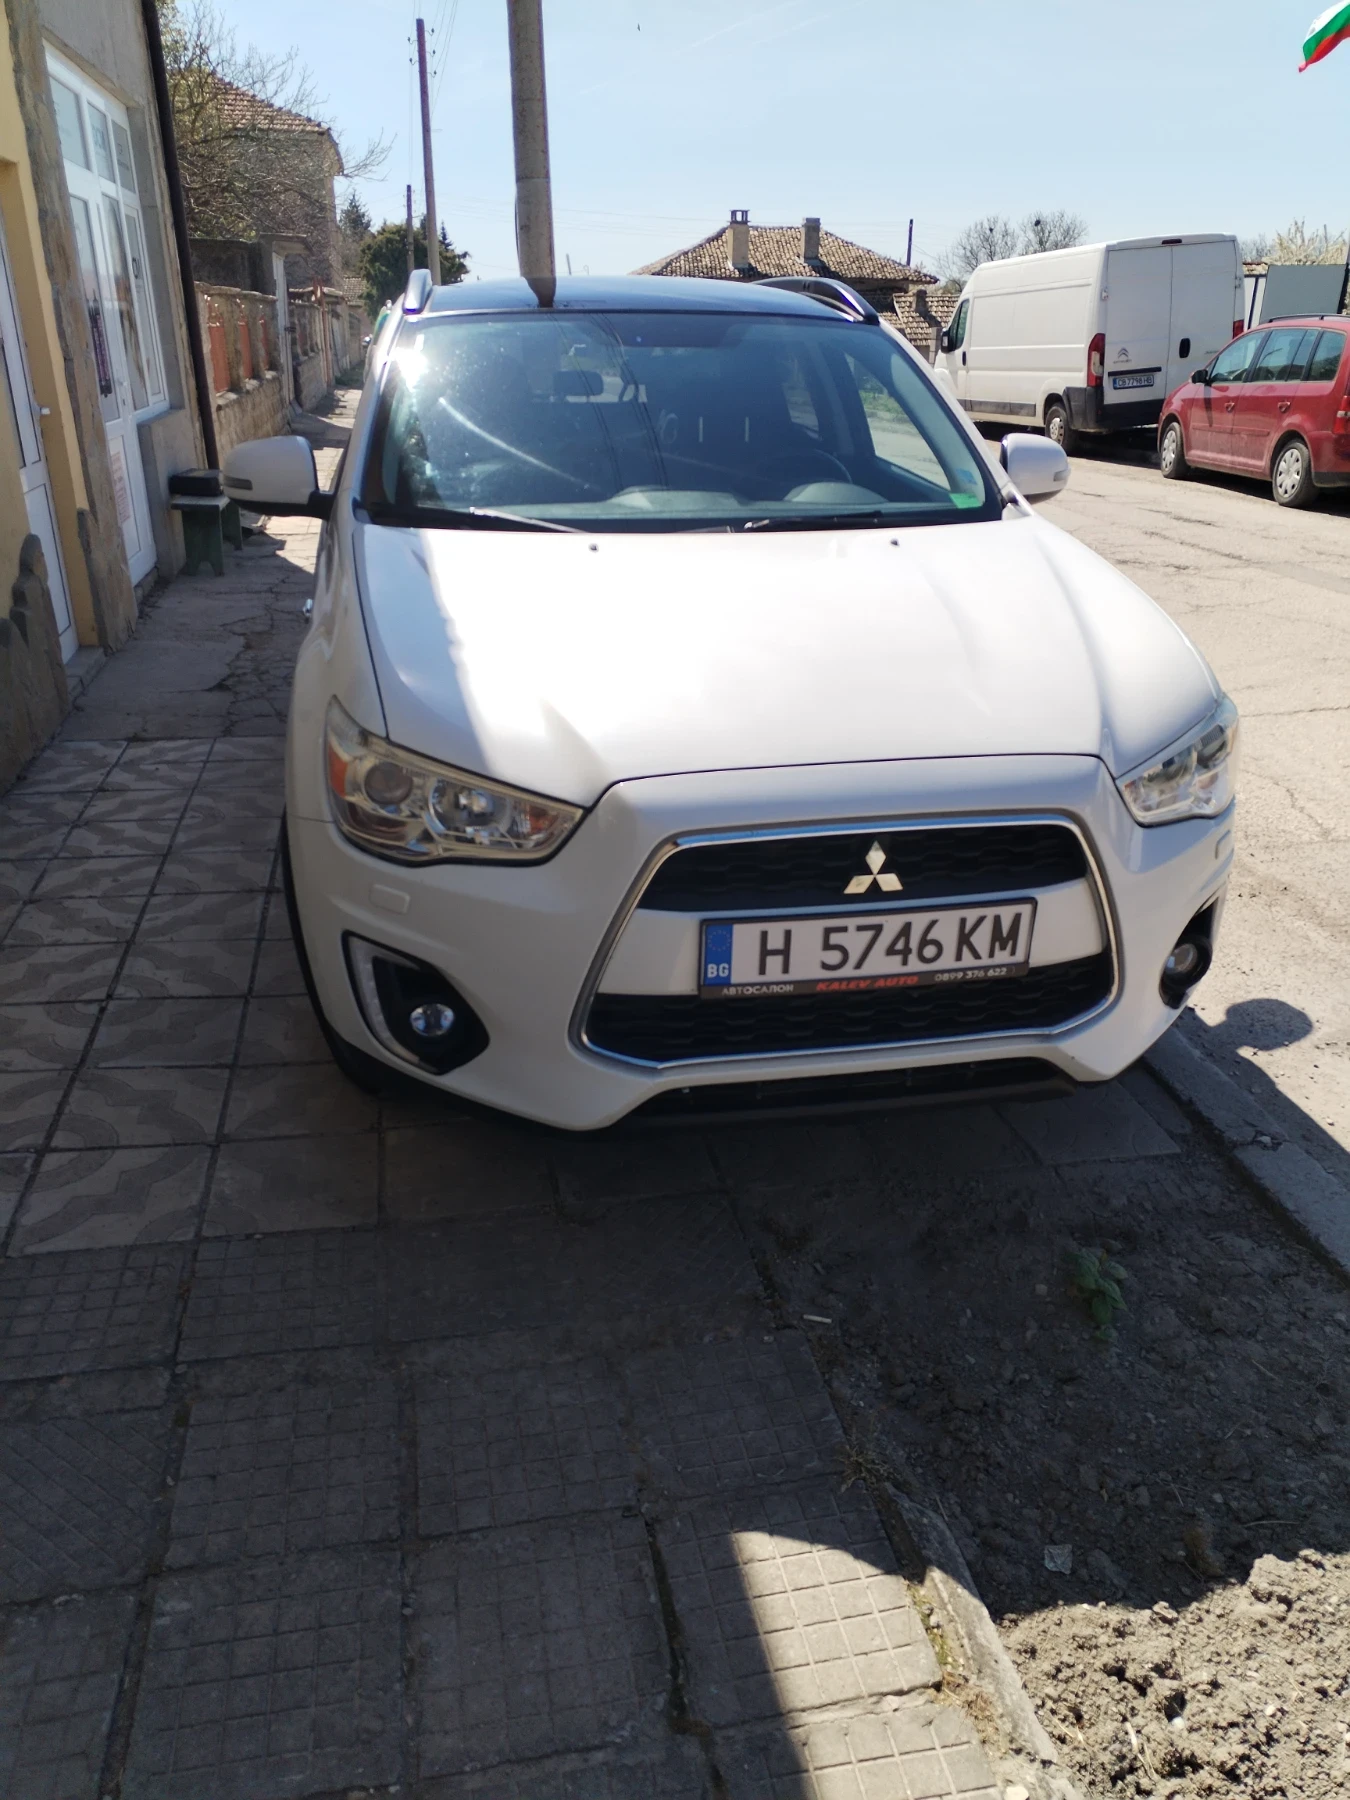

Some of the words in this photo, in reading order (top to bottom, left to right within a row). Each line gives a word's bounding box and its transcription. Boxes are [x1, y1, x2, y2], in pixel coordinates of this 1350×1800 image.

[758, 929, 792, 976] H
[820, 919, 944, 972] 5746
[955, 912, 1022, 962] KM
[707, 963, 729, 978] BG
[934, 972, 963, 982] 0899
[987, 967, 1007, 977] 622
[721, 984, 794, 996] АВТОСАЛОН
[815, 980, 872, 992] KALEV
[873, 975, 919, 988] AUTO
